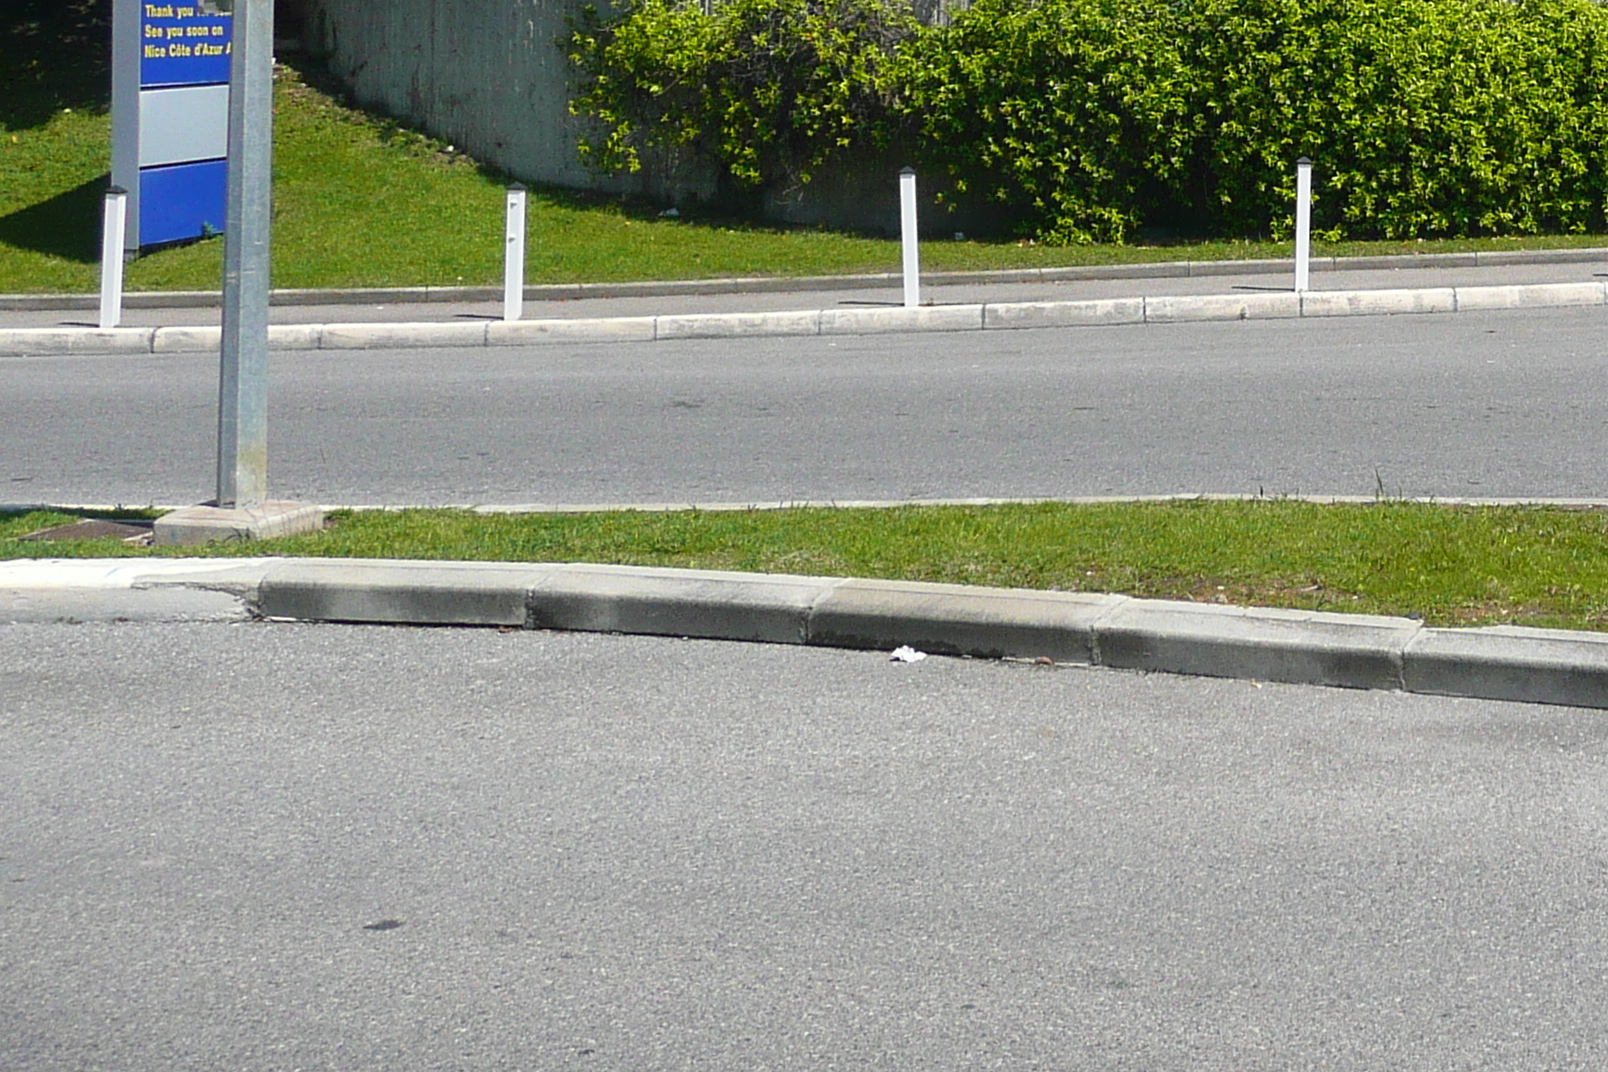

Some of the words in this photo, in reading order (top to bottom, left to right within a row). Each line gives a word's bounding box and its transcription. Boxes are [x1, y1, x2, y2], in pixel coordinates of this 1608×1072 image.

[145, 4, 174, 18] Thank
[177, 7, 194, 20] you
[145, 23, 163, 38] See
[166, 27, 184, 40] you
[186, 26, 209, 37] soon
[211, 25, 224, 37] on
[144, 44, 166, 58] Nice
[169, 43, 191, 57] Côte
[194, 43, 224, 57] d'Azur
